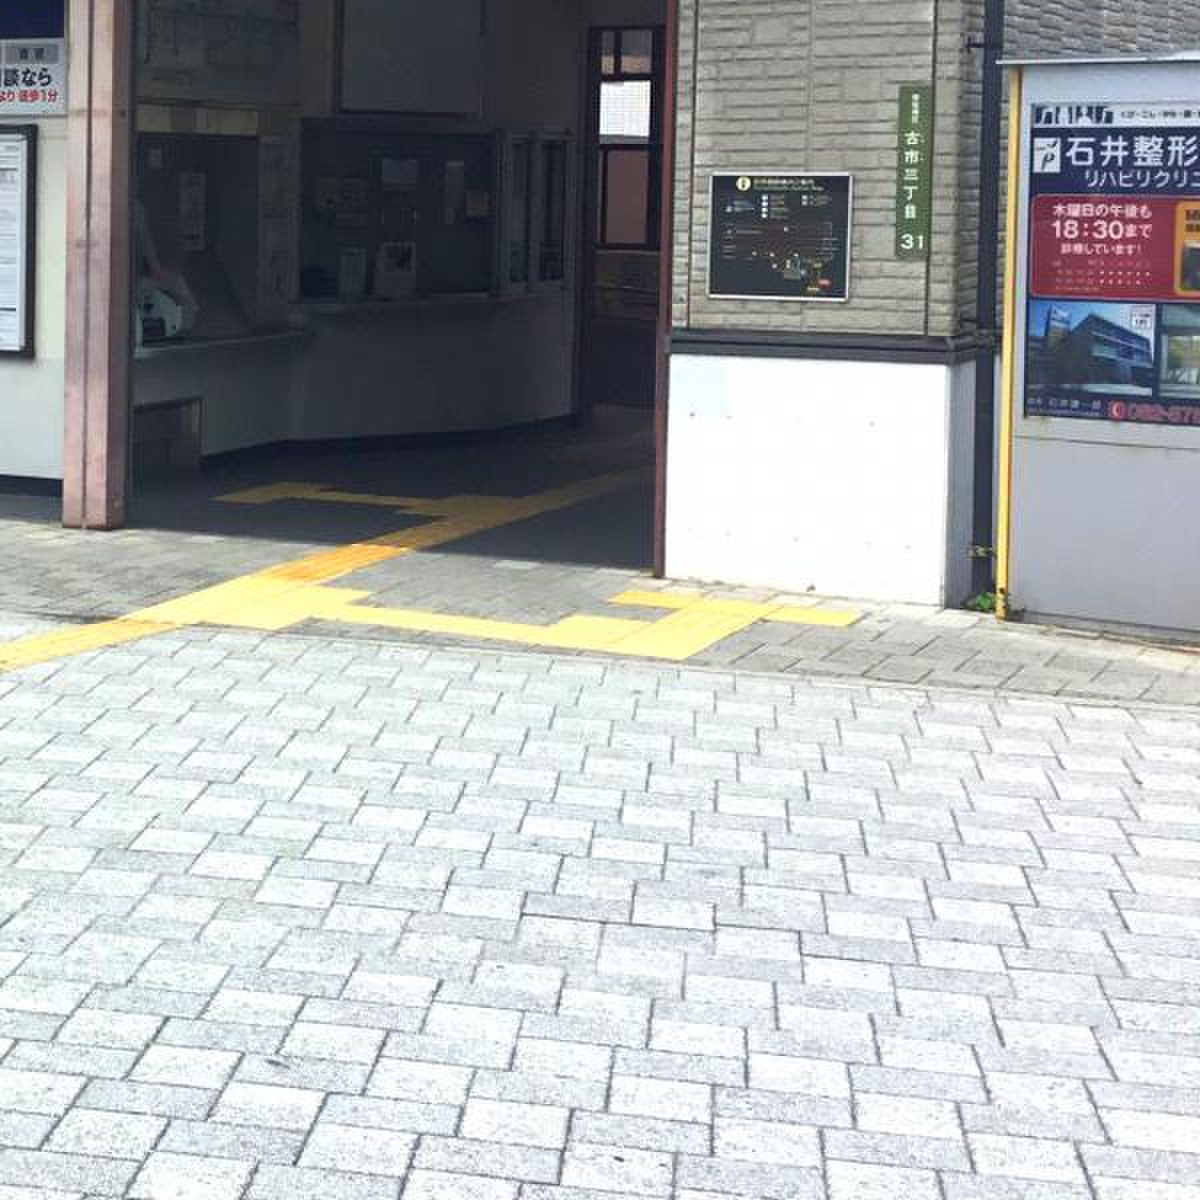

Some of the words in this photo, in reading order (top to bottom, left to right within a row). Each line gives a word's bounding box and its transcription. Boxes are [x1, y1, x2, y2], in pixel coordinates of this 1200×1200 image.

[1065, 135, 1199, 167] 石井整形
[904, 131, 921, 219] 古市三丁目
[900, 233, 924, 250] 31
